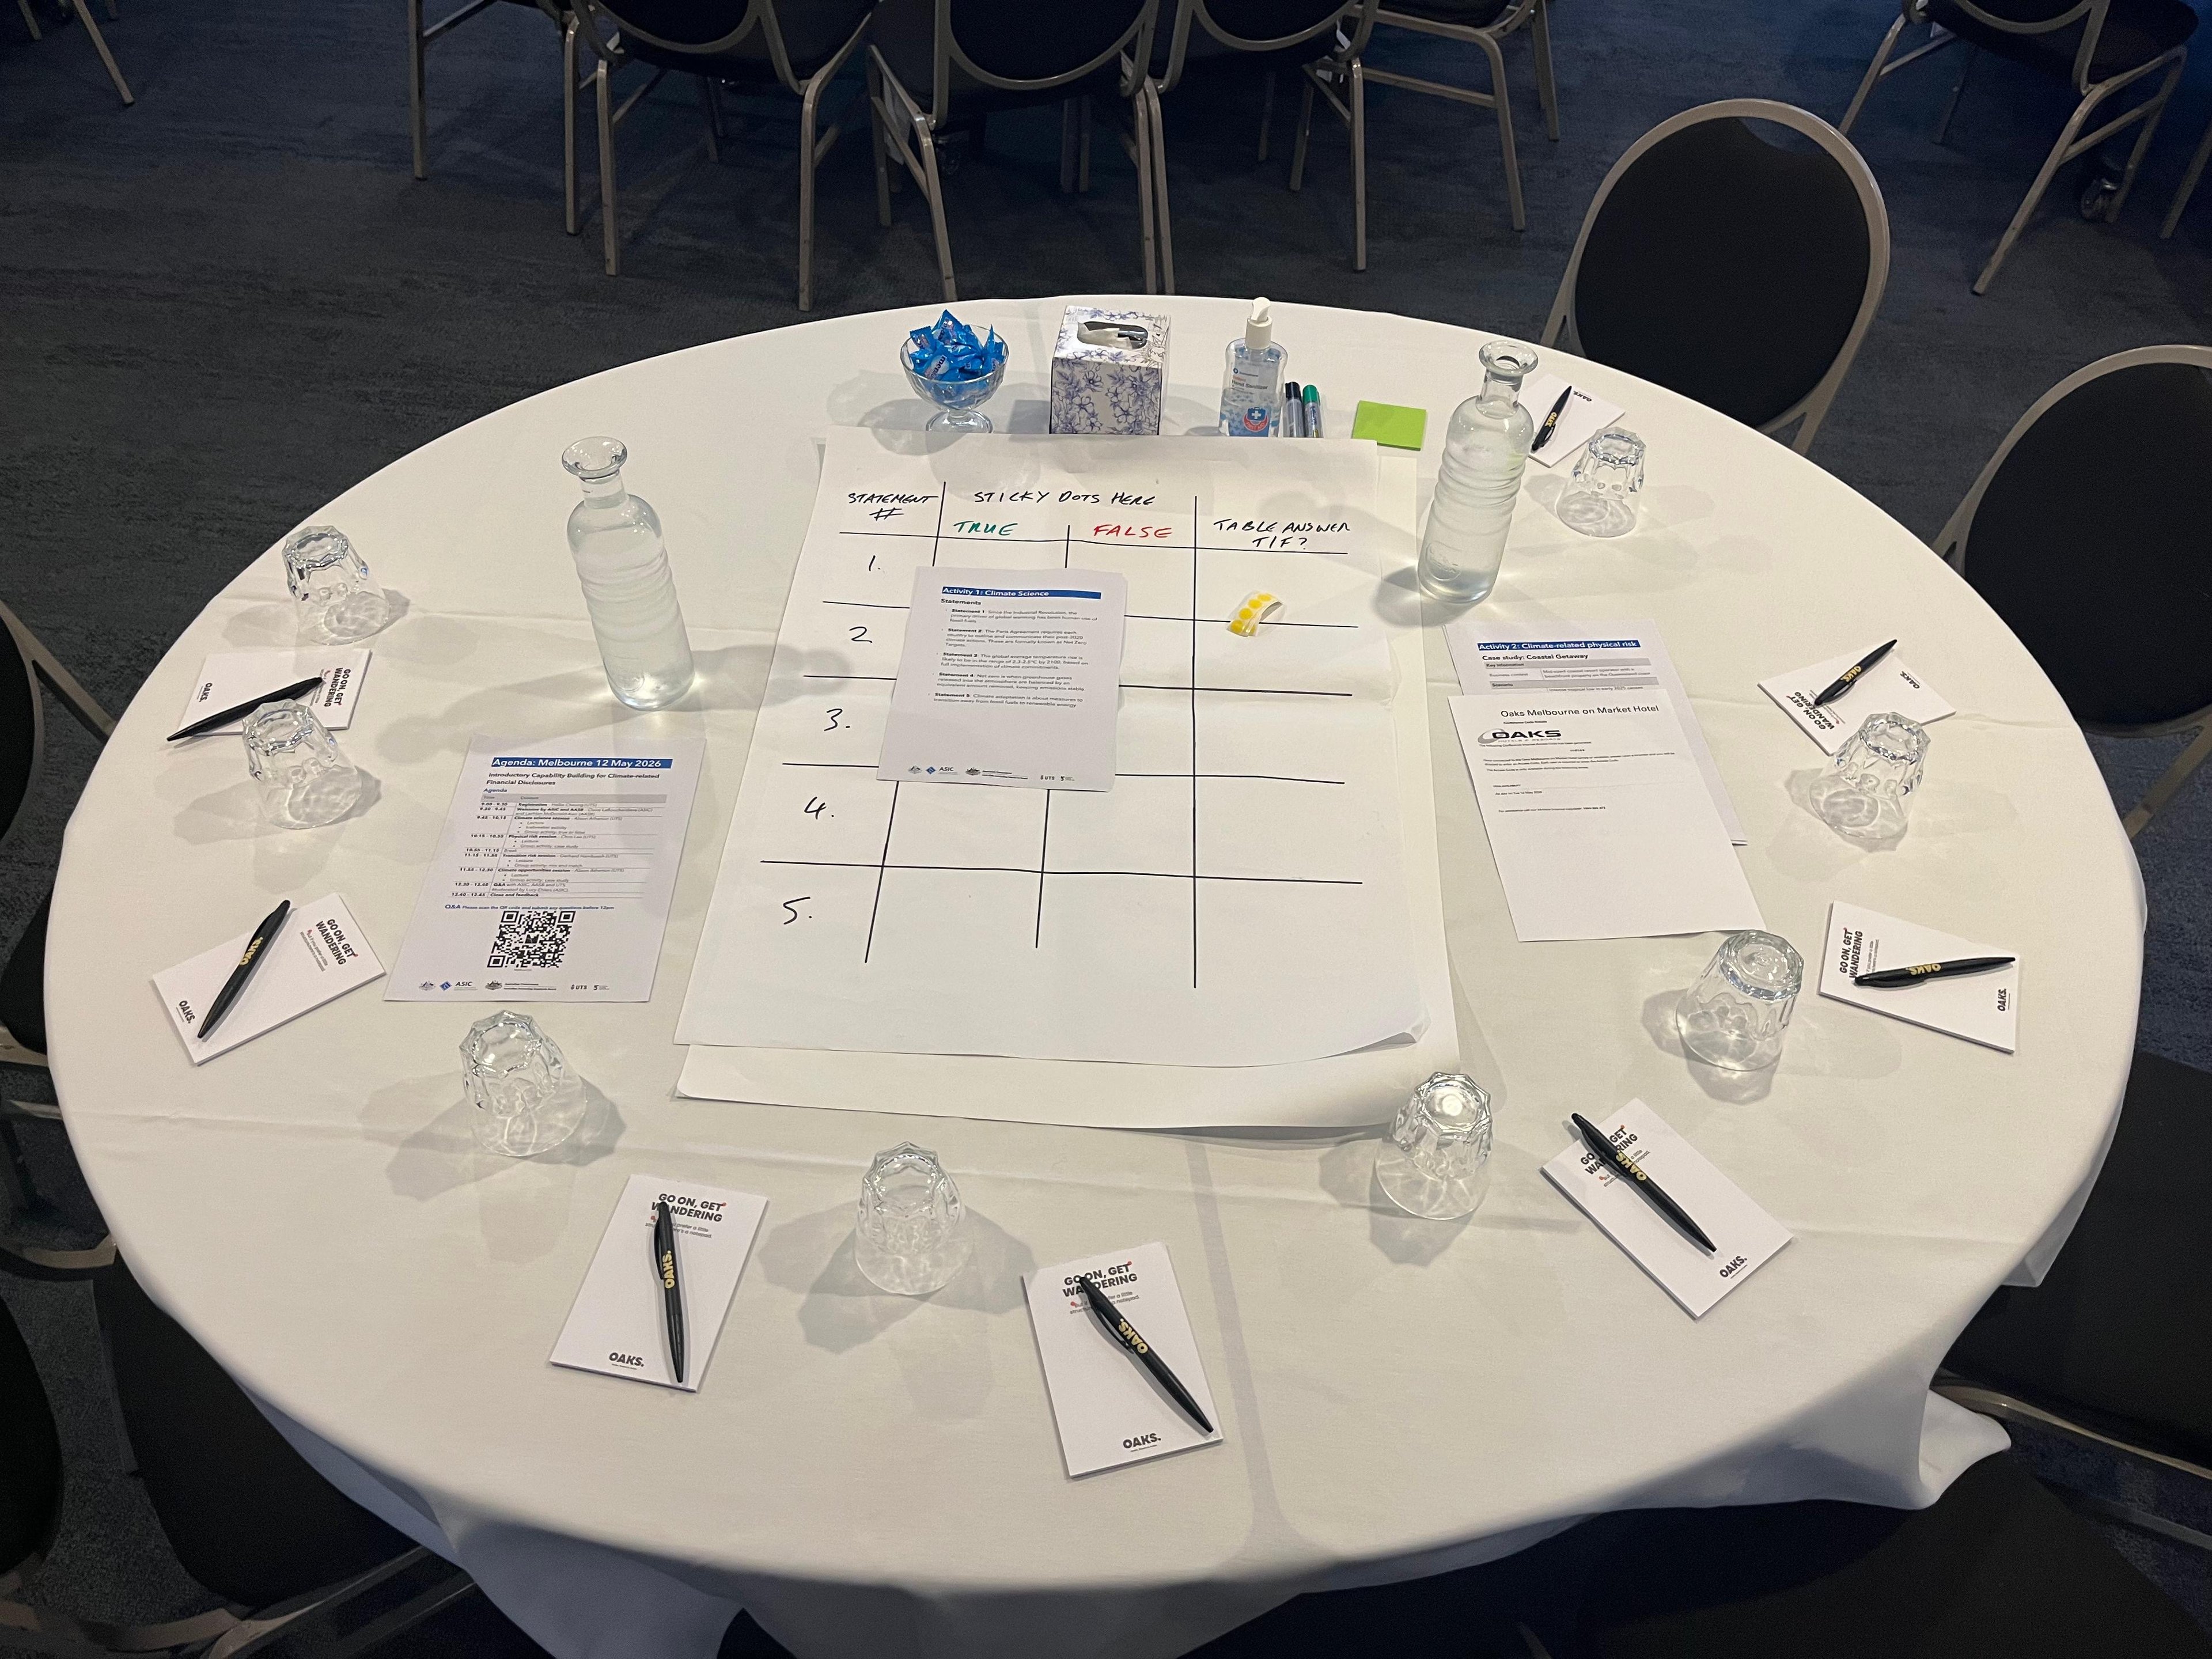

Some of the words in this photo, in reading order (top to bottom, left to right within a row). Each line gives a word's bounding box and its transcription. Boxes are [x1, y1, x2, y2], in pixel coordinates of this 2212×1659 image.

[848, 493, 938, 504] STATEMENT
[972, 488, 1050, 503] STICKY
[1058, 490, 1100, 503] DOTS
[1111, 493, 1155, 505] HERE
[869, 507, 904, 521] #
[953, 521, 1018, 536] TRUE
[1093, 525, 1173, 537] FALSE
[1214, 519, 1278, 532] TABLE
[1282, 522, 1350, 533] ANSWER
[869, 555, 881, 571] 1.
[849, 627, 872, 643] 2
[342, 669, 351, 679] GO
[198, 683, 213, 702] OAKS.
[324, 668, 343, 707] WANDERING
[337, 680, 347, 691] ON,
[334, 693, 343, 704] GET
[823, 708, 851, 732] 3.
[1527, 707, 1580, 716] Melbourne
[1492, 729, 1561, 739] OAKS
[804, 796, 835, 820] 4.
[783, 896, 813, 925] 5.
[316, 921, 346, 965] WANDERING
[327, 919, 338, 930] GO
[334, 930, 346, 945] ON,
[342, 943, 354, 957] GET
[1843, 930, 1853, 945] GET
[1841, 948, 1851, 961] ON,
[1839, 961, 1848, 973] GO
[1998, 988, 2007, 1012] OAKS.
[179, 999, 196, 1024] OAKS.
[1581, 1153, 1594, 1165] GO
[1609, 1128, 1627, 1143] GET
[658, 1193, 676, 1203] GO
[677, 1196, 698, 1209] ON,
[700, 1201, 722, 1211] GET
[651, 1202, 723, 1222] WNDERING
[662, 1249, 676, 1289] OAKS.
[1064, 1275, 1081, 1285] GO
[1084, 1270, 1106, 1281] ON,
[1108, 1264, 1130, 1275] GET
[1719, 1255, 1748, 1279] OAKS.
[1062, 1273, 1138, 1297] WADERING
[1118, 1317, 1149, 1354] OAKS.
[609, 1352, 645, 1367] OAKS.
[1122, 1433, 1162, 1450] OAKS.
